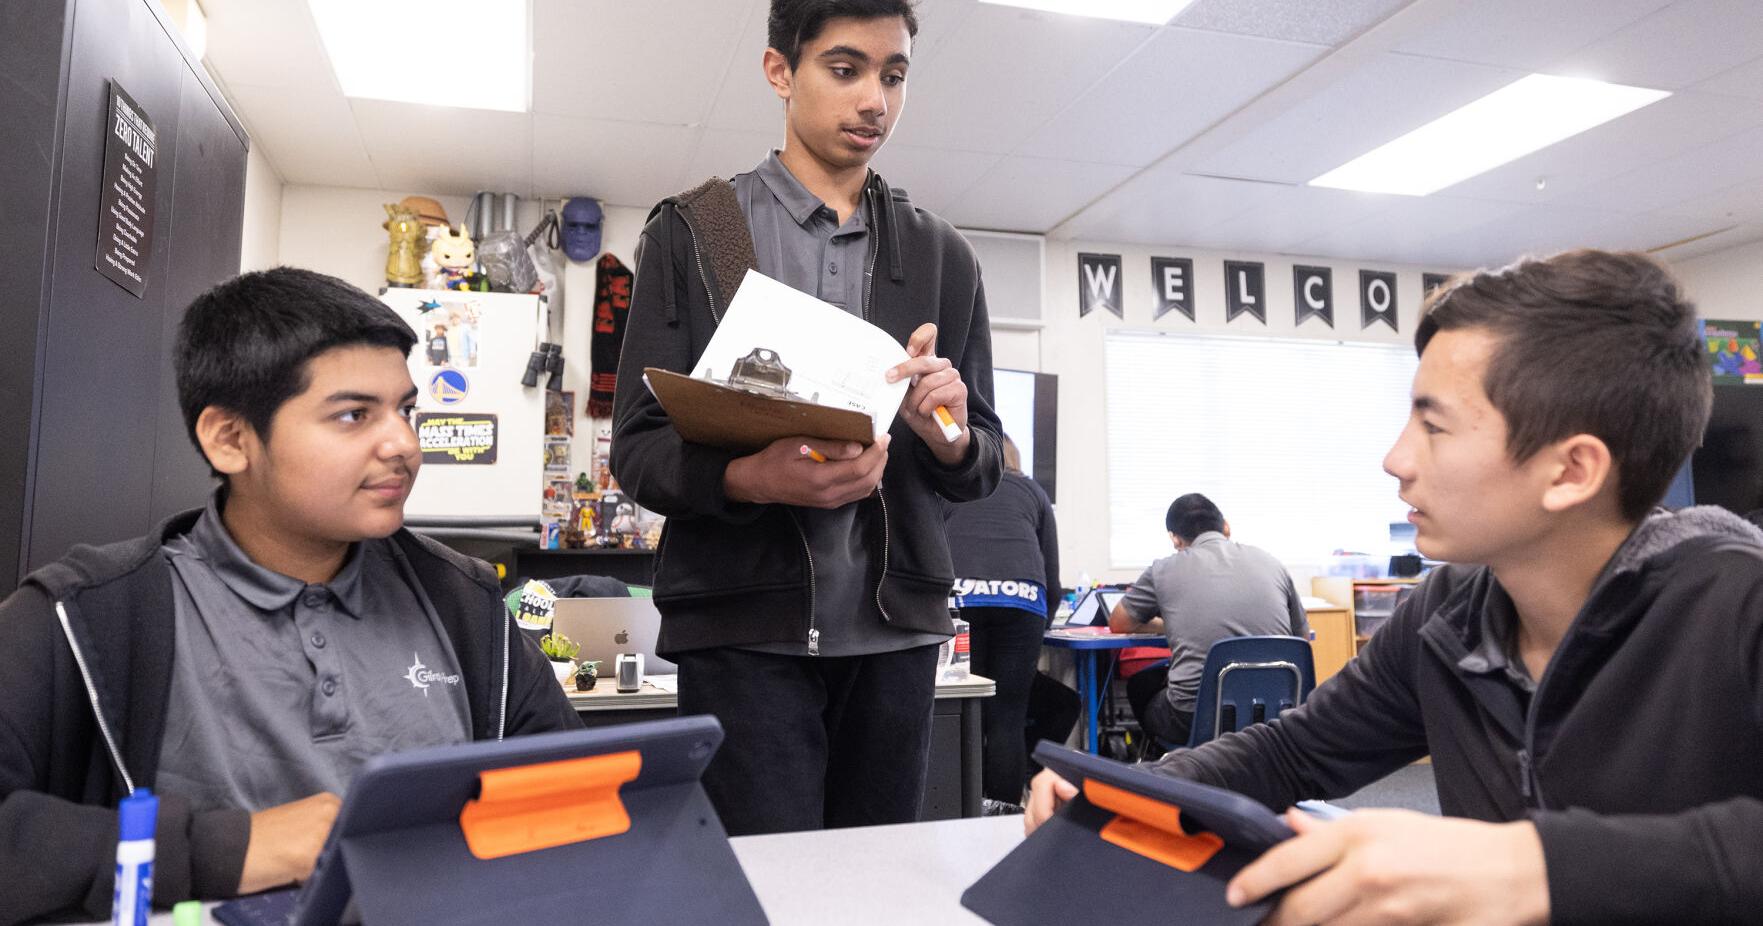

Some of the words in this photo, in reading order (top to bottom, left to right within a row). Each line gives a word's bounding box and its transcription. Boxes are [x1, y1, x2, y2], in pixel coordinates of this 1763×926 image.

[115, 113, 132, 147] ZERO
[132, 130, 155, 168] TALENT
[419, 425, 454, 439] MASS
[456, 424, 494, 437] TIMES
[419, 436, 493, 448] ACCELERATION
